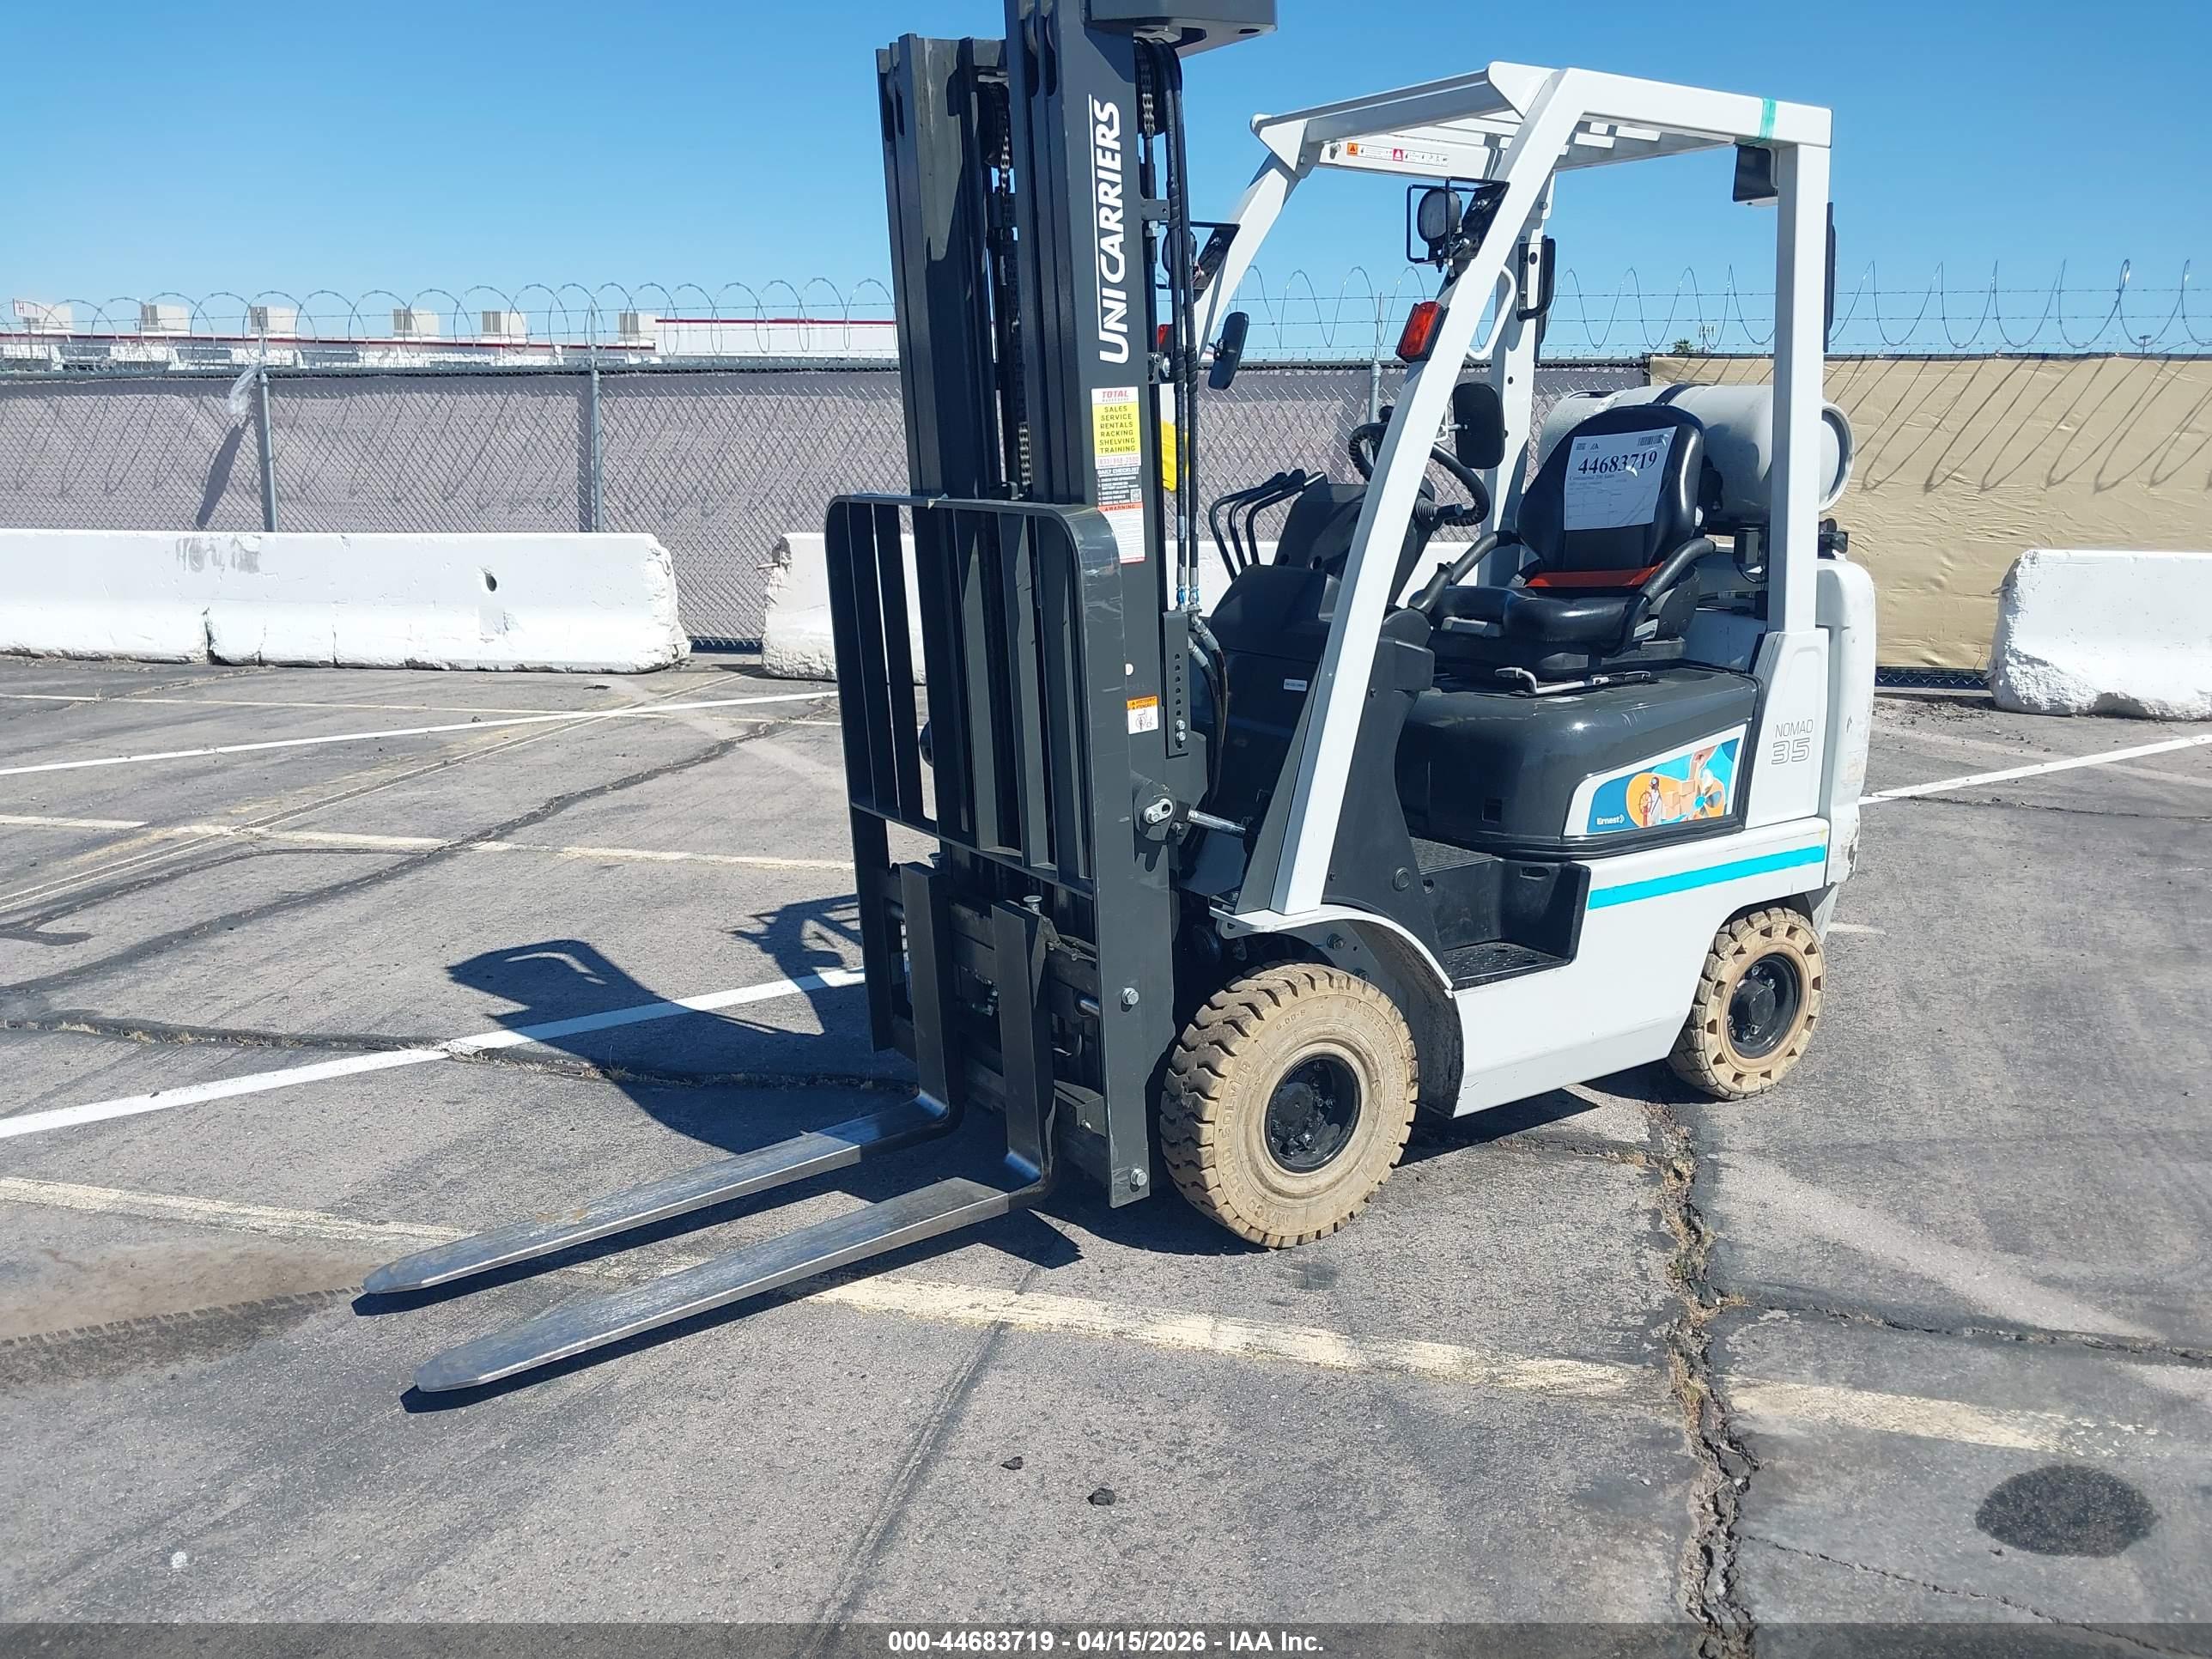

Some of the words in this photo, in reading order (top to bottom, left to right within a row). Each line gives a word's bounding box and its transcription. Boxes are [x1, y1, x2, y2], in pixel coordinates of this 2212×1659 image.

[1102, 390, 1128, 398] TOTAL
[1101, 413, 1133, 422] SERVICE
[1099, 437, 1135, 446] SHELVING
[1099, 445, 1136, 453] TRAINING
[1577, 450, 1658, 475] 44683719
[1775, 719, 1814, 738] NOMAD
[1771, 737, 1811, 765] 35
